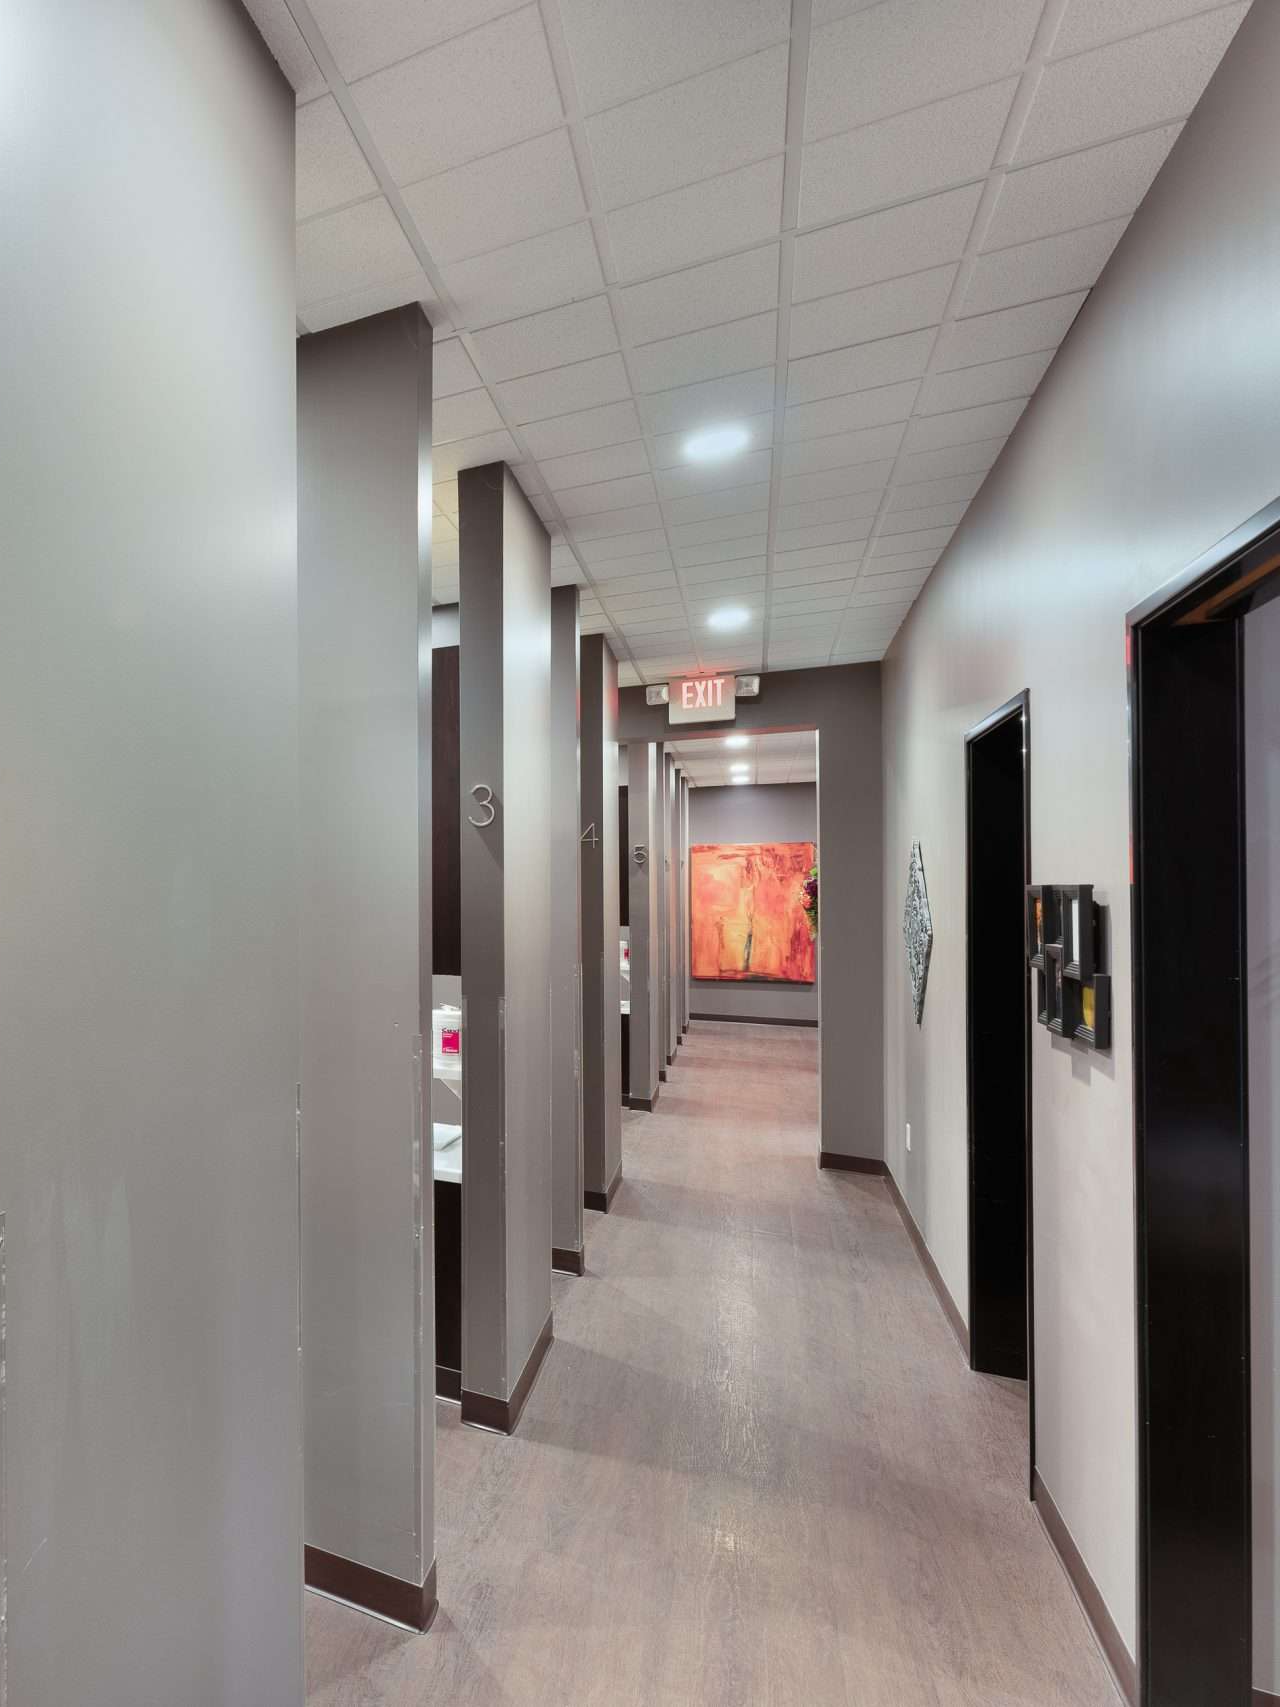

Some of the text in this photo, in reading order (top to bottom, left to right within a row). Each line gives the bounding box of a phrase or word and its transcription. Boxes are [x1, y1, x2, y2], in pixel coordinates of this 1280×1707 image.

[682, 679, 725, 709] EXIT
[468, 784, 495, 827] 3
[579, 823, 599, 849] 4
[633, 844, 647, 864] 5
